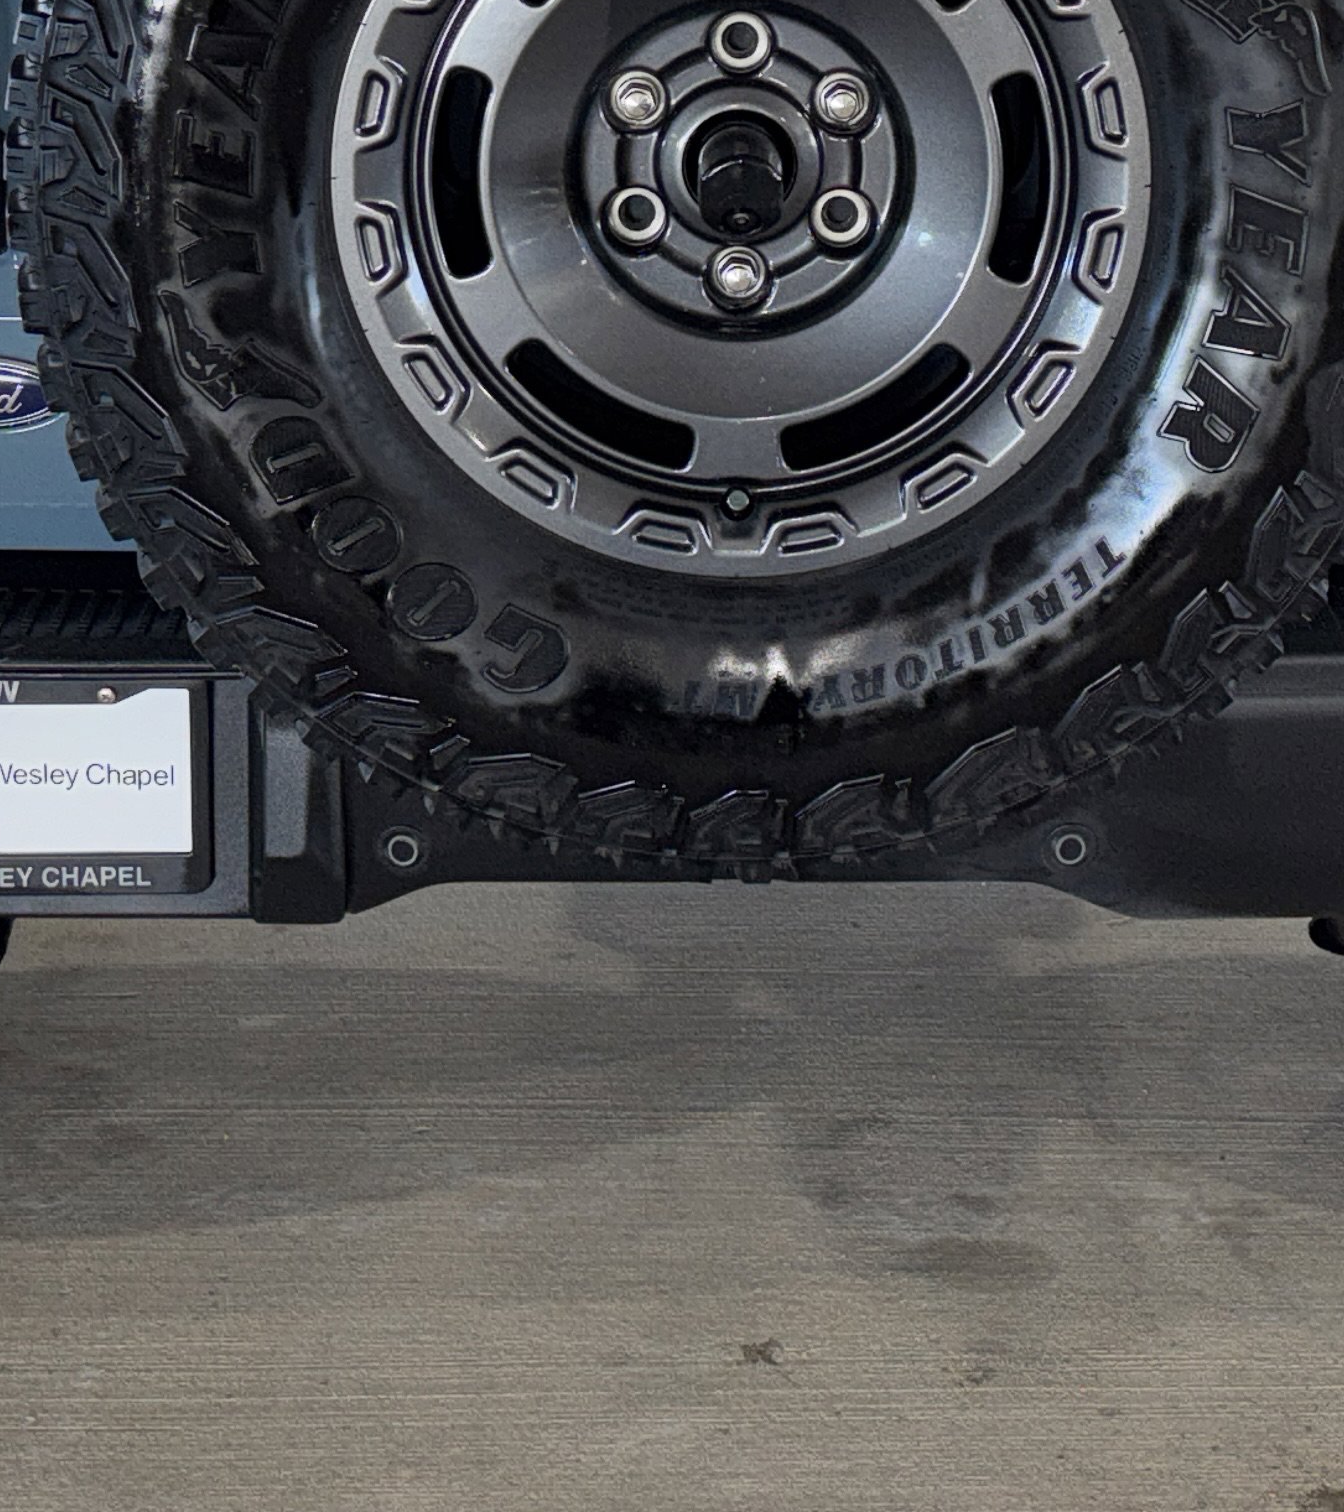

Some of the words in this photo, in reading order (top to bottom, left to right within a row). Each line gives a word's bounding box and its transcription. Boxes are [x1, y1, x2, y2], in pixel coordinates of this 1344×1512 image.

[812, 535, 1127, 714] TERRITORY
[85, 763, 174, 790] Chapel
[41, 866, 152, 887] CHAPEL
